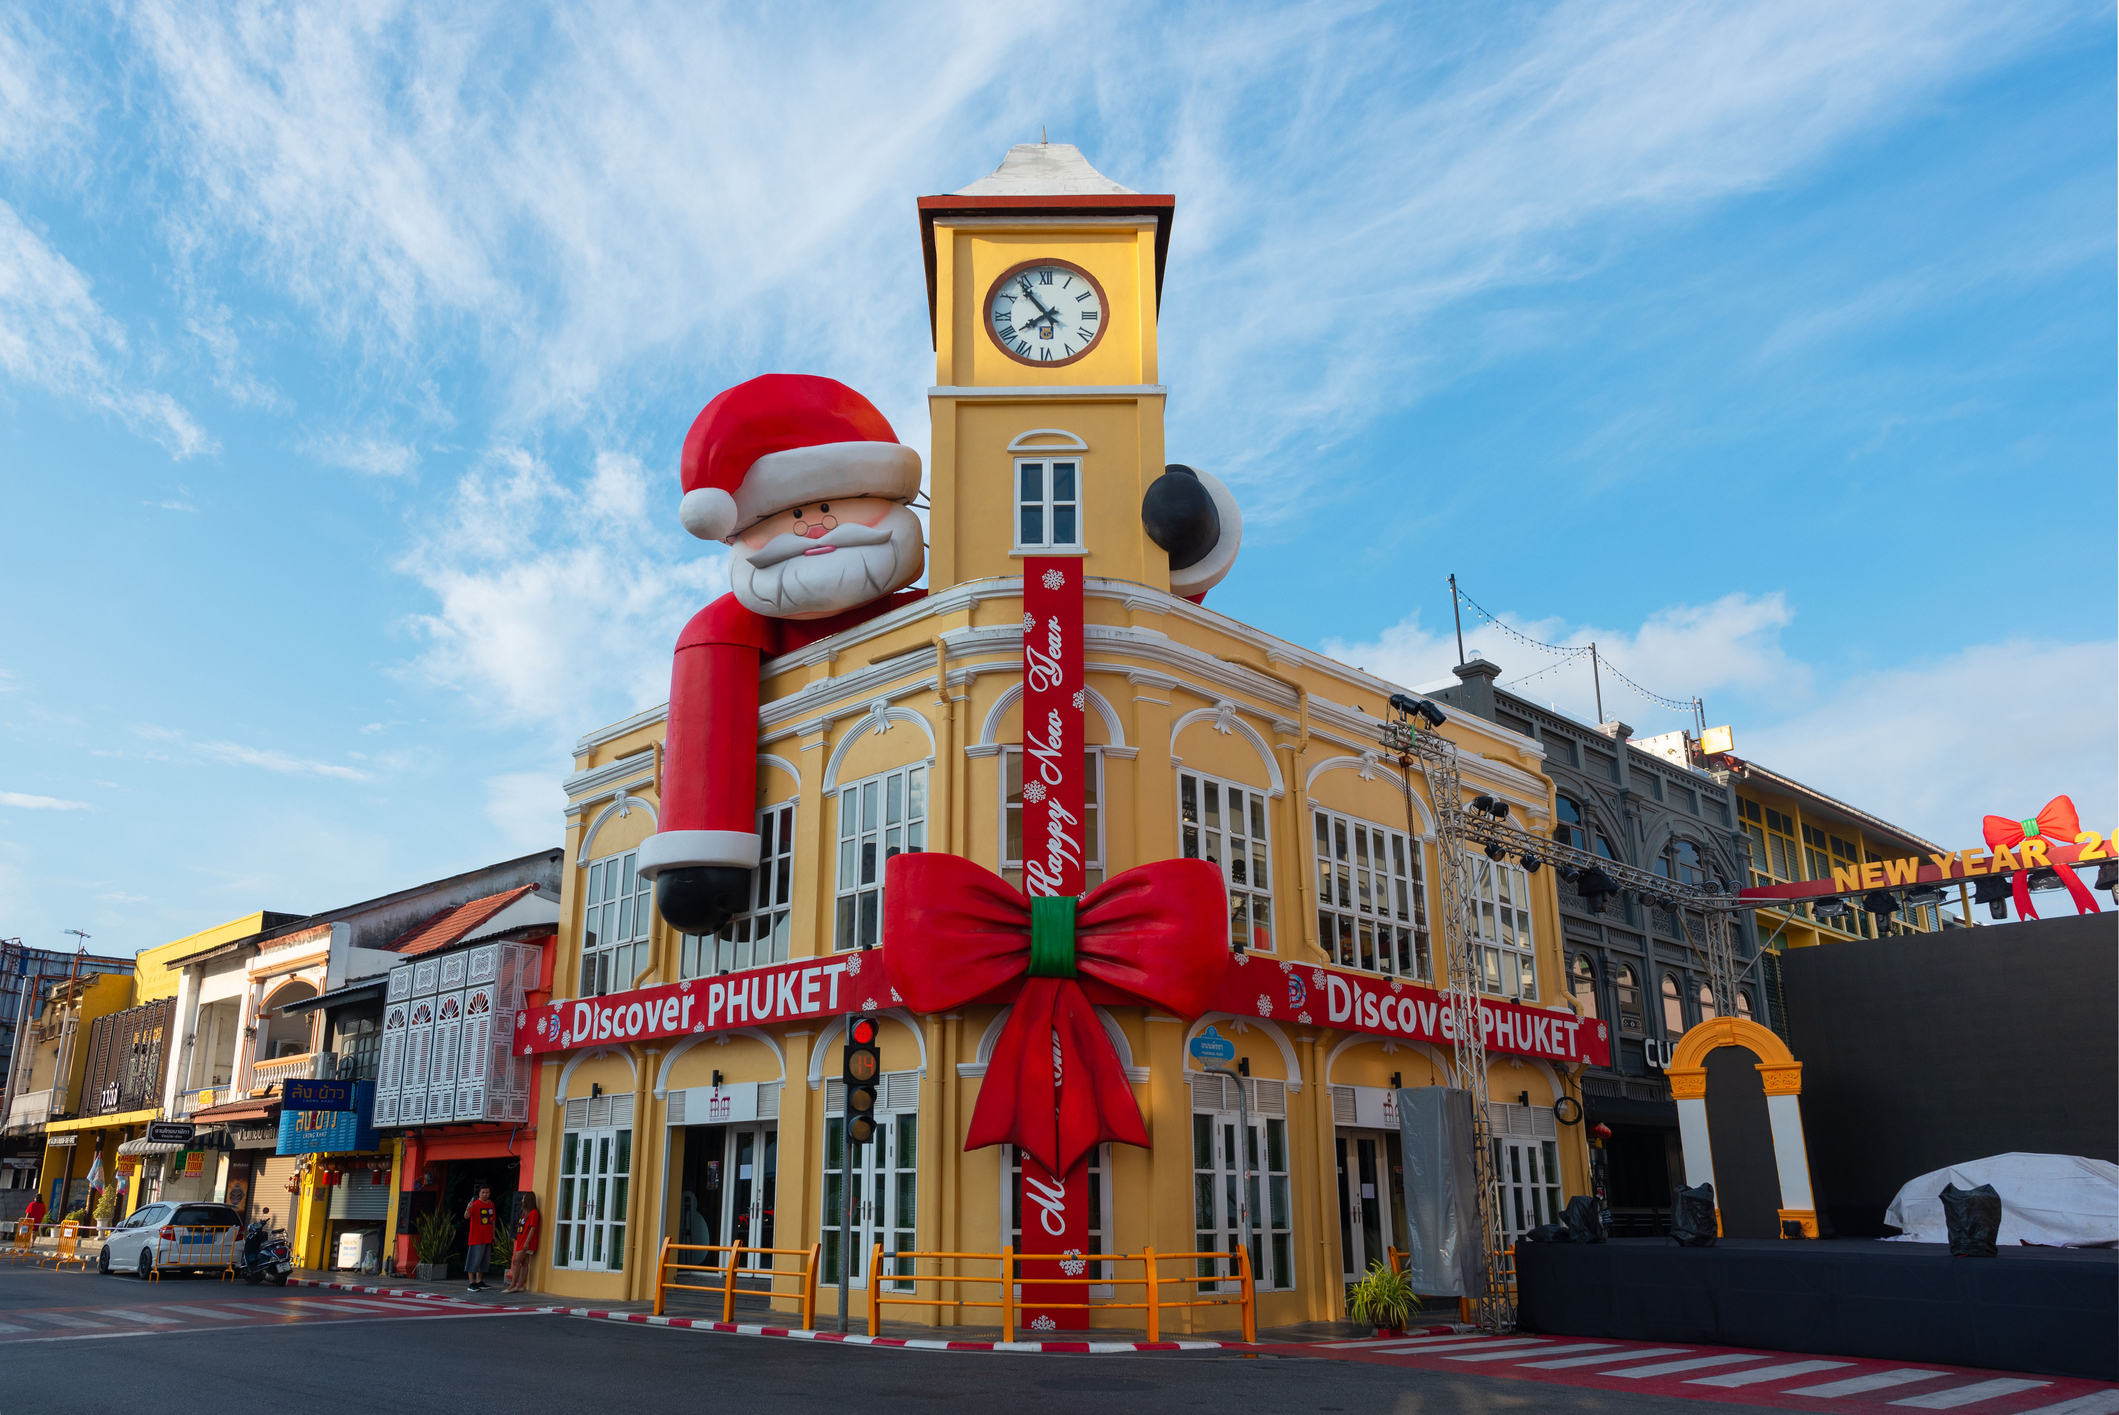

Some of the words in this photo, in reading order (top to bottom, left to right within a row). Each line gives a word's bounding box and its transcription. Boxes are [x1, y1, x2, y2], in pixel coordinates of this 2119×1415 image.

[1038, 270, 1054, 285] XII
[1026, 615, 1063, 693] Year
[1026, 707, 1063, 786] New
[1026, 797, 1081, 897] Happy
[1832, 856, 1920, 893] NEW
[1928, 838, 2053, 880] YEAR
[572, 993, 695, 1043] Discover
[707, 962, 847, 1027] PHUKET
[1482, 1005, 1580, 1057] PHUKET
[1644, 1038, 1679, 1070] CU
[858, 1056, 874, 1075] 14
[187, 1152, 205, 1162] ARIES
[187, 1162, 203, 1171] TOUR
